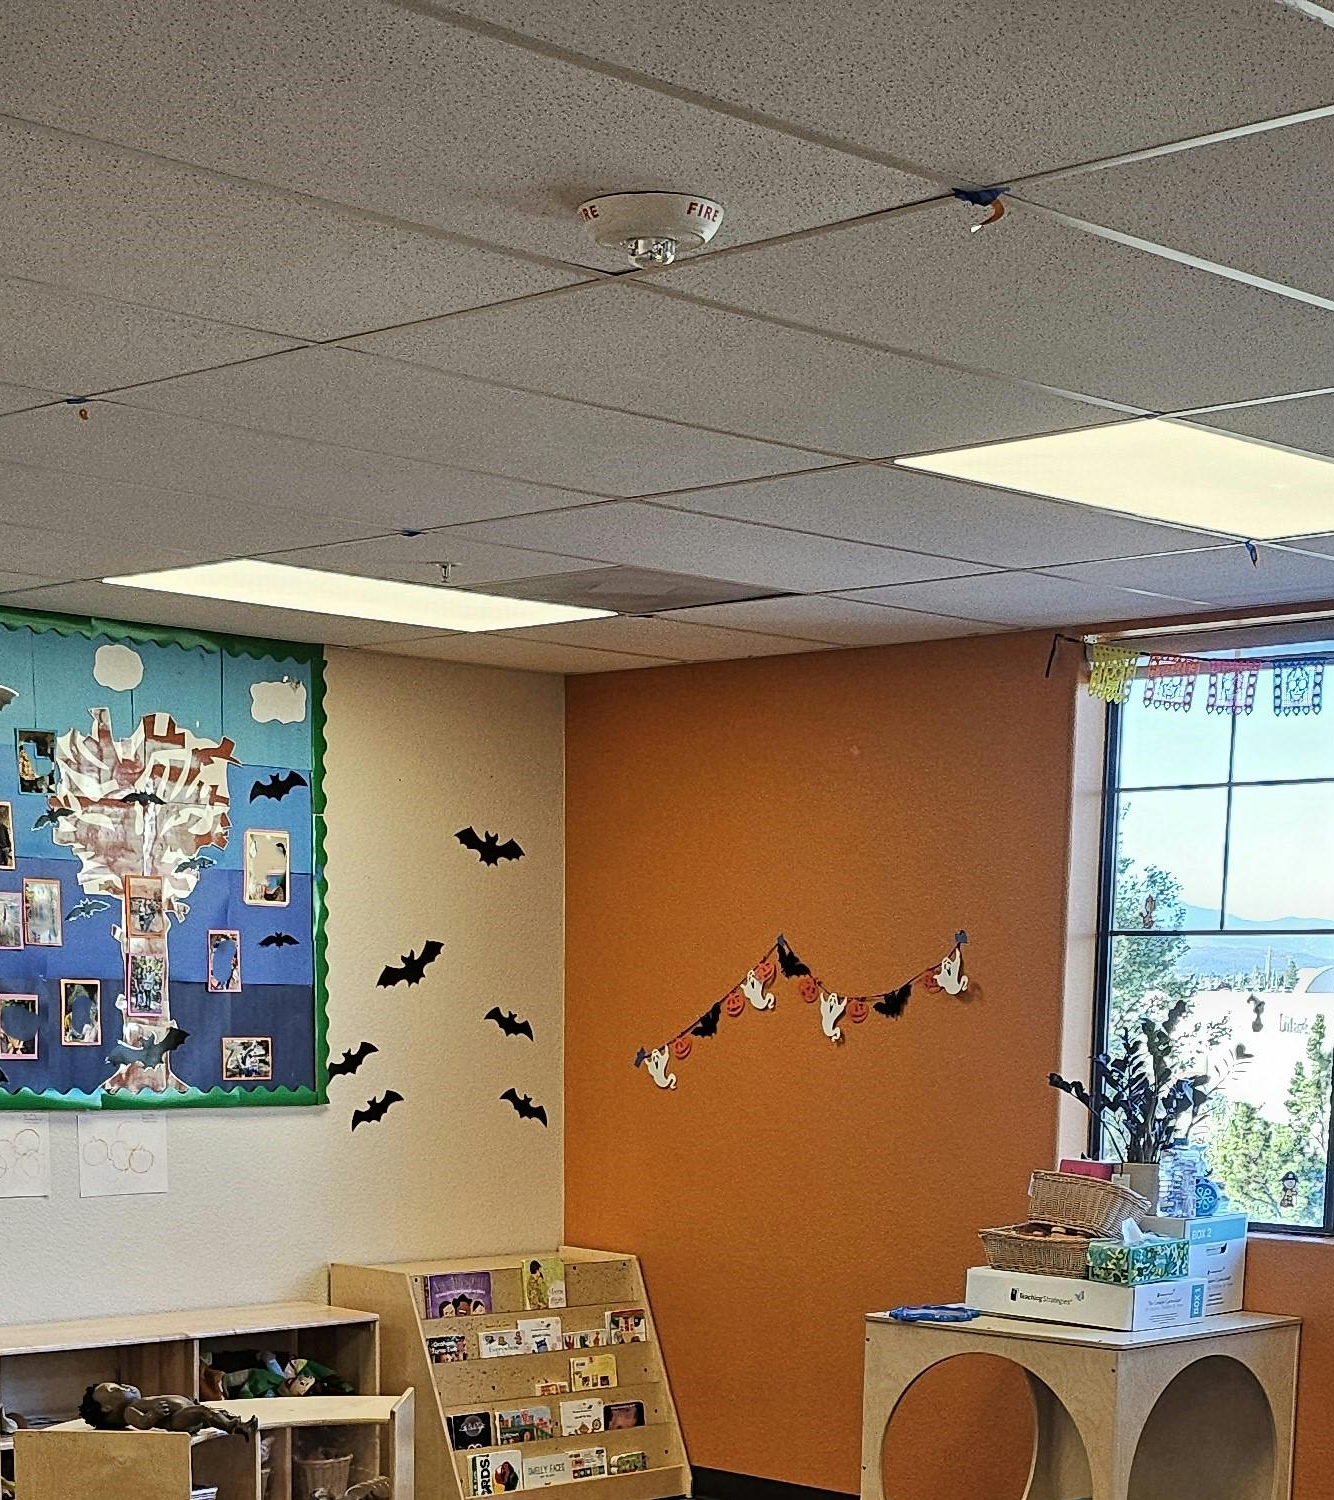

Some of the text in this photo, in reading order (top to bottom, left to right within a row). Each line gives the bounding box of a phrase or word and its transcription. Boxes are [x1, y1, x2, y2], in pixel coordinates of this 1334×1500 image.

[686, 201, 720, 223] FIRE
[1192, 1228, 1212, 1240] BOX 2
